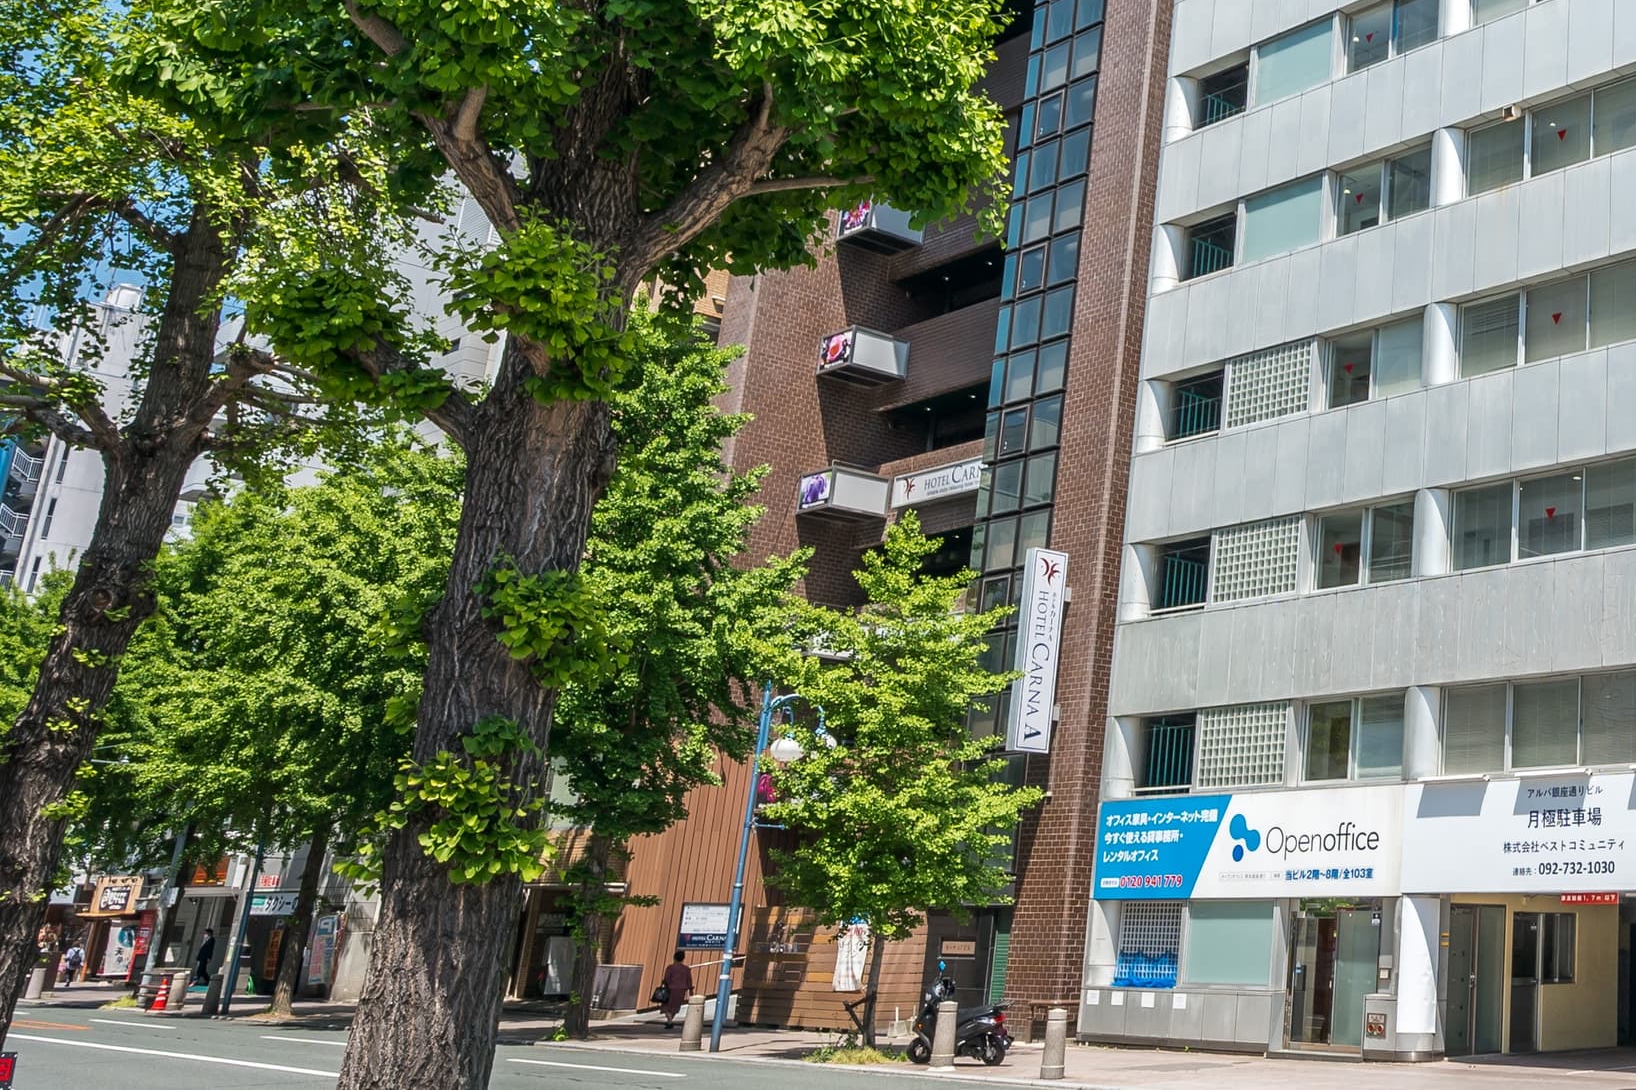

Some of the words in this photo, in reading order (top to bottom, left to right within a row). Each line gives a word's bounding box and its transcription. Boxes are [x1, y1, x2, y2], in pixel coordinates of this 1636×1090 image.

[924, 474, 950, 490] HOTEL
[1034, 590, 1049, 638] HOTEL
[1026, 642, 1050, 716] CARNA
[1023, 723, 1042, 742] A
[1527, 807, 1603, 829] 月極駐車場
[1266, 822, 1379, 861] Openoffice
[1503, 839, 1625, 854] 株式会社ベストコミュニティ
[1103, 850, 1159, 863] レンタルオフィス
[1538, 861, 1615, 876] 092-732-1030
[1120, 875, 1142, 888] 0120
[1145, 875, 1162, 887] 941
[1164, 874, 1183, 887] 779
